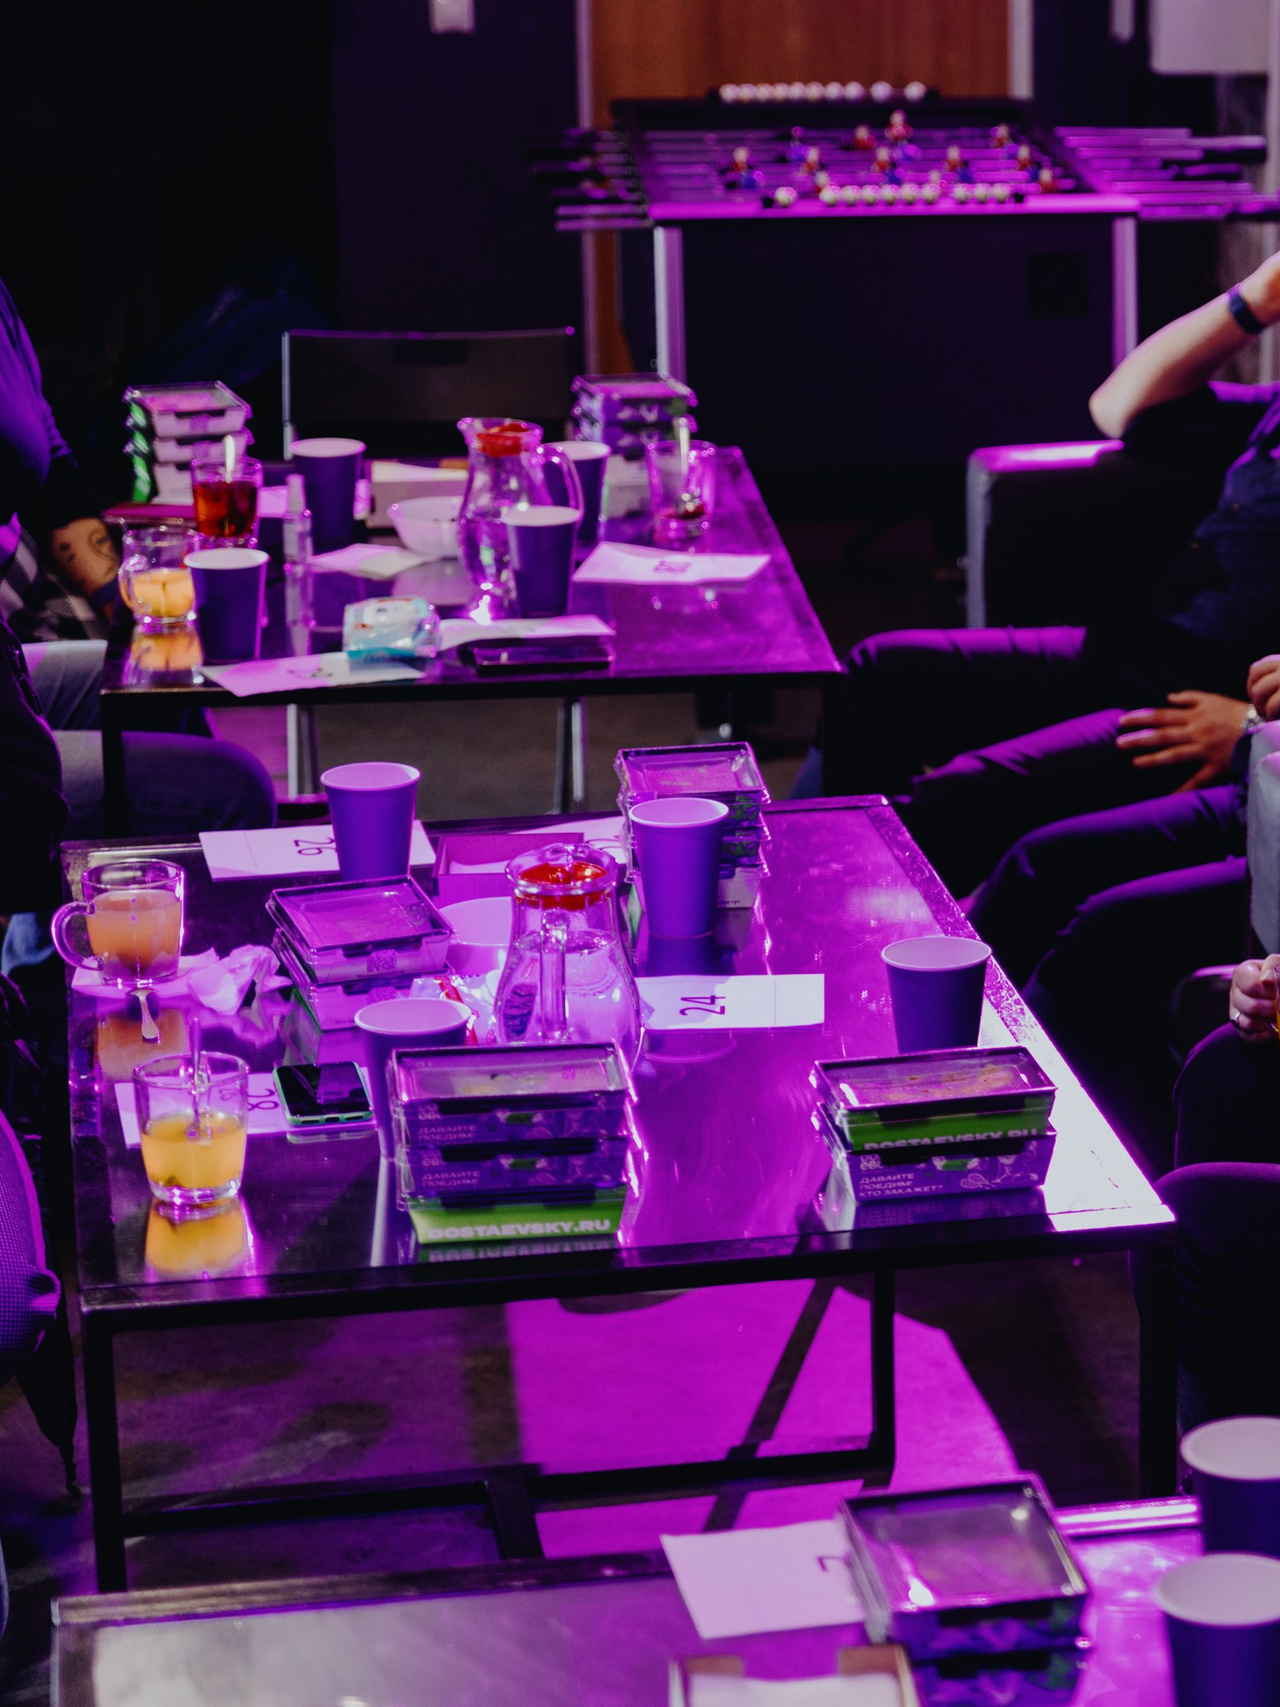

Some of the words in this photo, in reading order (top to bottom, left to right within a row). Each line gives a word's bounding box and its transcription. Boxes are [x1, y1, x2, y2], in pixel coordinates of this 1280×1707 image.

[293, 836, 338, 856] 26
[679, 995, 726, 1016] 24
[859, 1173, 915, 1185] ДАВАЙТЕ
[859, 1190, 882, 1198] КТО
[427, 1218, 612, 1240] DOSTAEVSKY.RU
